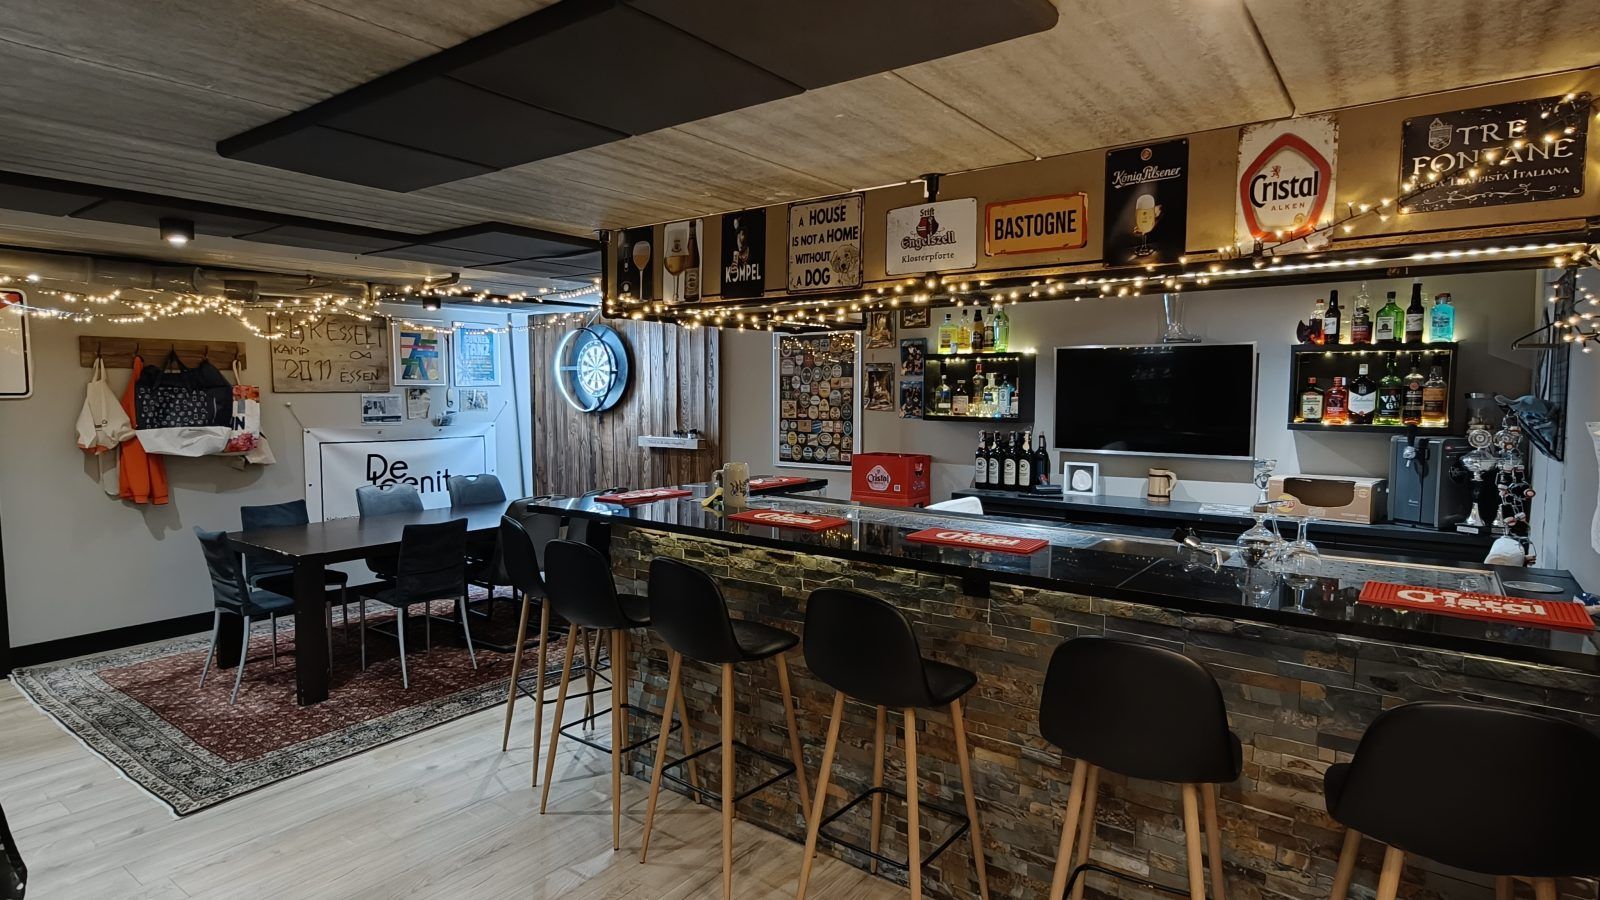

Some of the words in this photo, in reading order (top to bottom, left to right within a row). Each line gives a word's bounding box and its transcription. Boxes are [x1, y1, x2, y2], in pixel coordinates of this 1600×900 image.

[1456, 119, 1528, 145] TRE
[1412, 138, 1576, 175] FONTANE
[1112, 169, 1142, 186] König
[1142, 165, 1181, 181] Pilsener
[1513, 166, 1570, 179] ITALIANA
[1250, 171, 1319, 208] Cristal
[799, 217, 804, 227] A
[809, 205, 846, 226] HOUSE
[1271, 202, 1305, 211] ALKEN
[994, 209, 1077, 241] BASTOGNE
[792, 236, 799, 247] IS
[800, 234, 818, 246] NOT
[819, 233, 825, 244] A
[827, 226, 859, 243] HOME
[901, 231, 957, 251] Engelszell
[795, 250, 831, 265] WITHOUT
[901, 252, 955, 264] Klosterpforte
[797, 276, 802, 286] A
[805, 267, 831, 287] DOG
[309, 316, 382, 348] KESSELT
[340, 368, 380, 383] ESSEN
[366, 453, 408, 482] De
